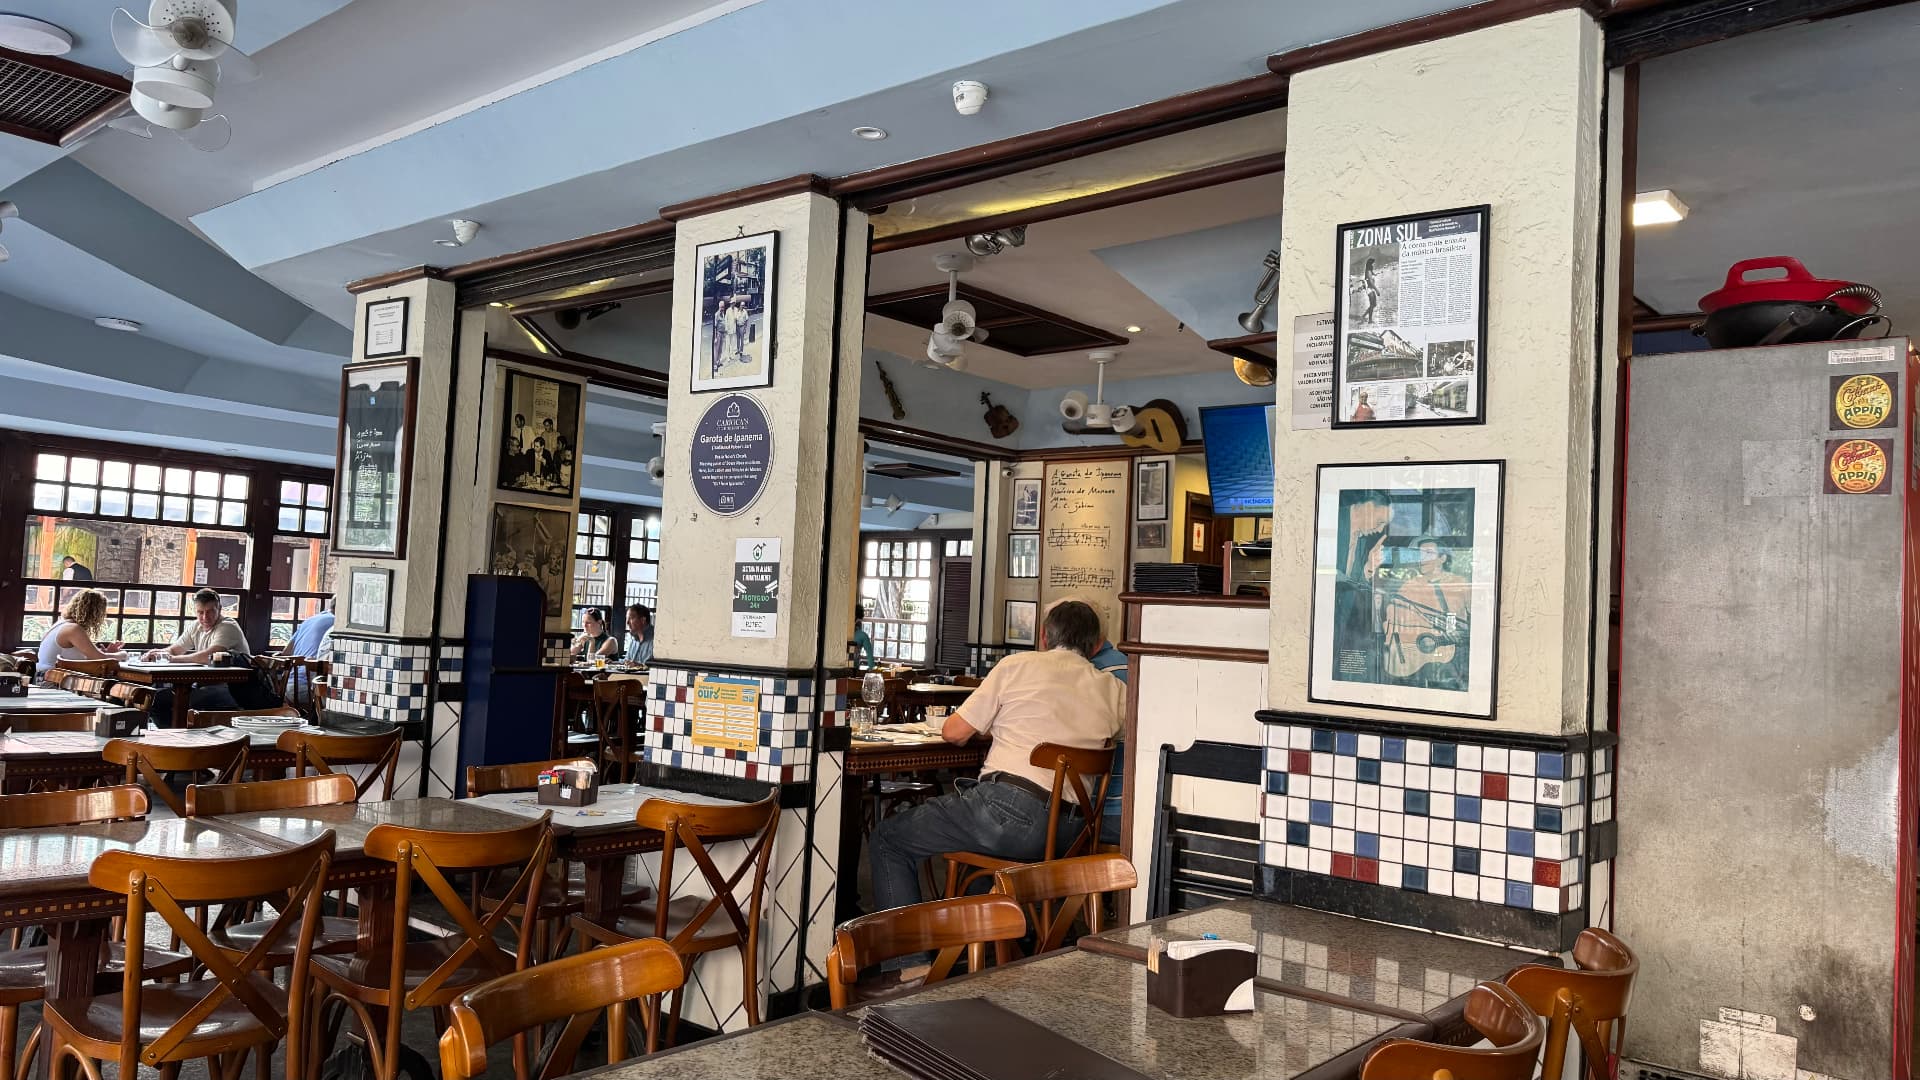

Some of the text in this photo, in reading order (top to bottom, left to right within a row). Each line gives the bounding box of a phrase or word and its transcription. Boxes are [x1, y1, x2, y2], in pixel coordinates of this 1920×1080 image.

[1357, 226, 1392, 249] ZONA
[1396, 222, 1423, 243] SUL
[1428, 239, 1443, 247] mais
[1435, 244, 1466, 254] brasileira
[1844, 406, 1883, 421] APPIA
[700, 433, 762, 444] Garota de Ipanema
[1096, 467, 1122, 481] Ipanema
[1838, 471, 1877, 485] APPIA
